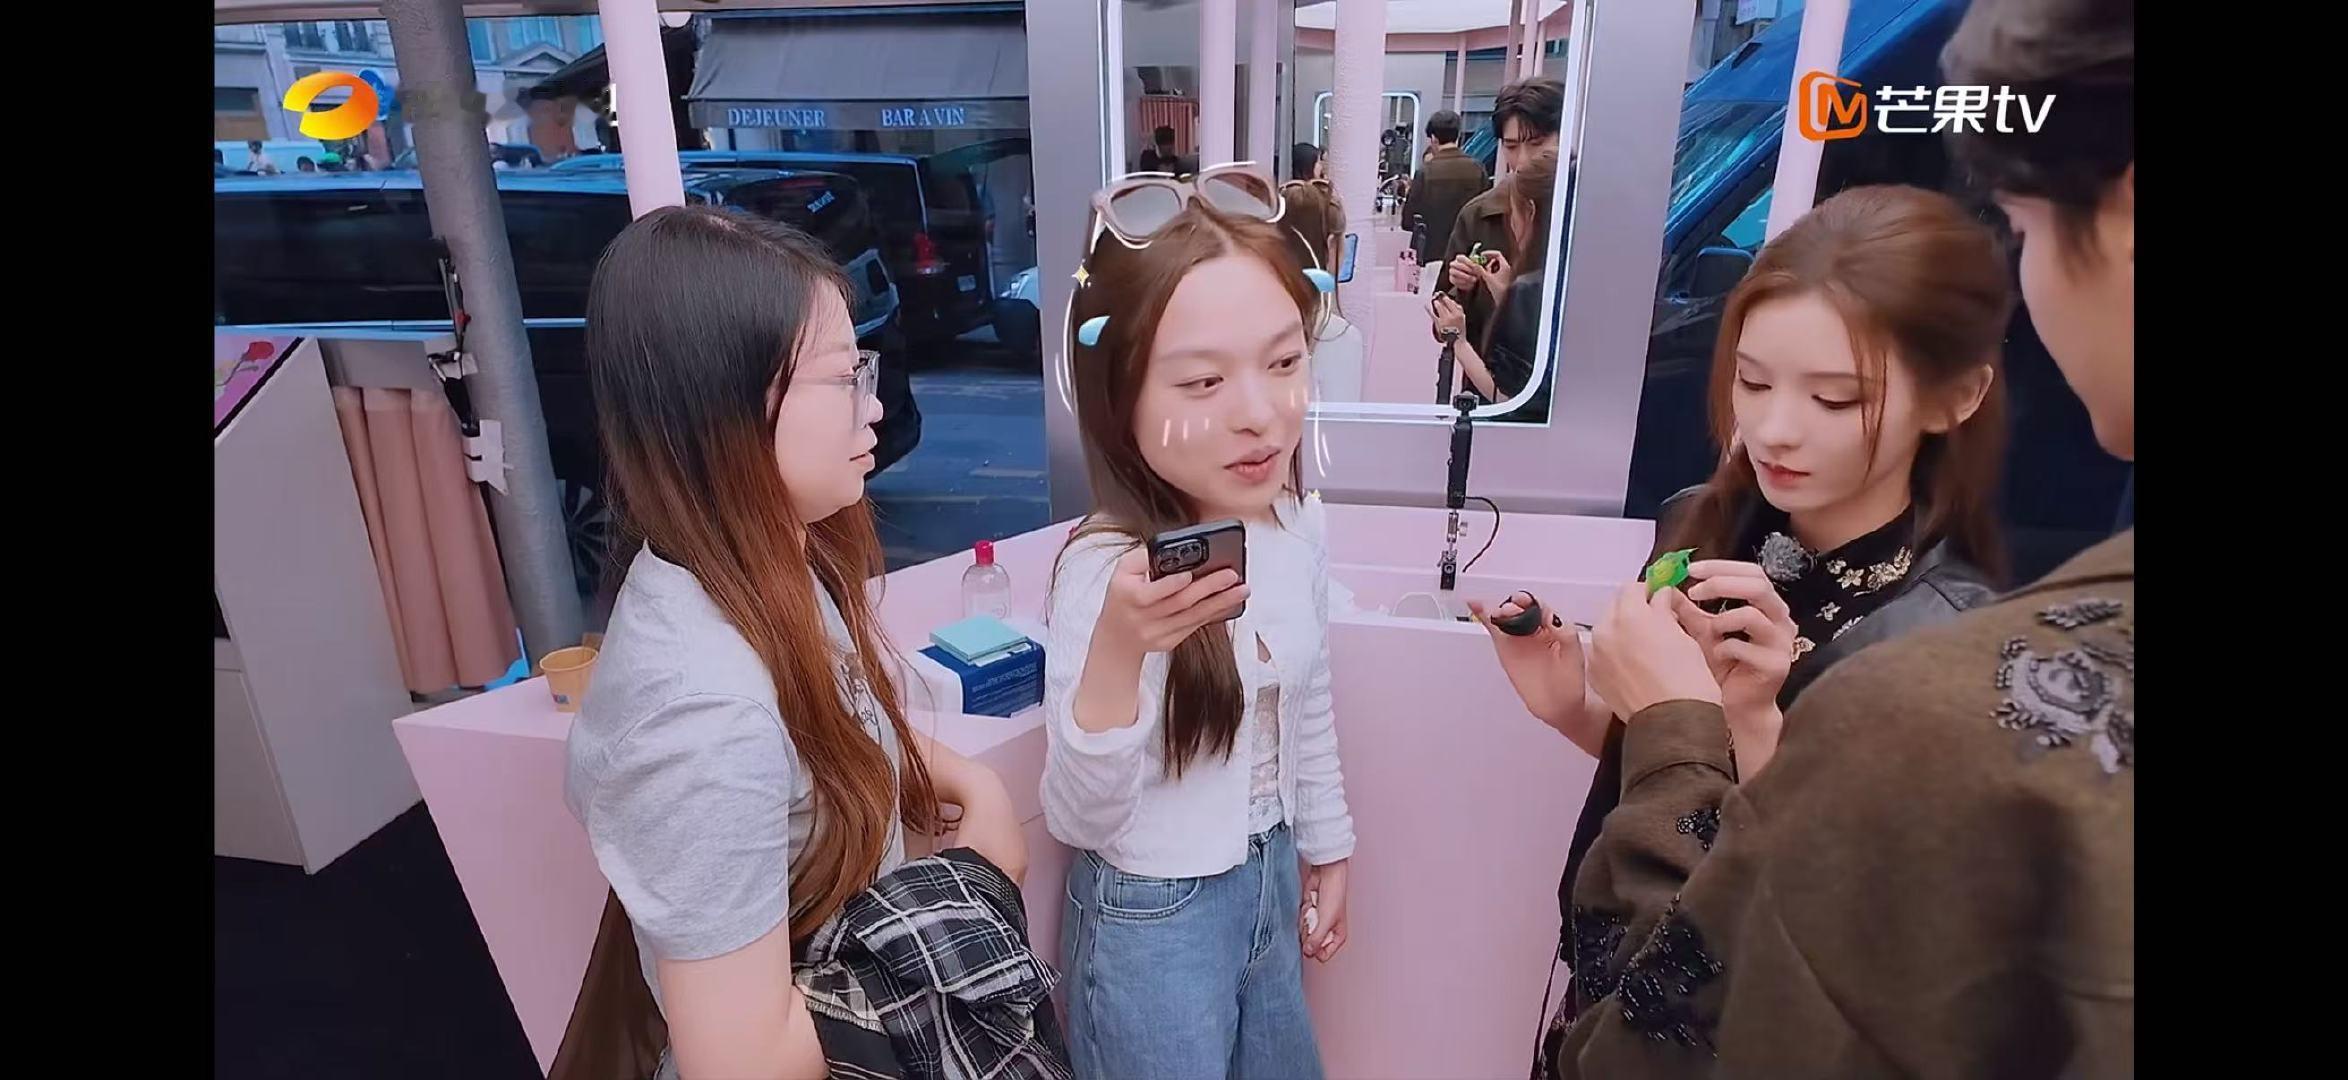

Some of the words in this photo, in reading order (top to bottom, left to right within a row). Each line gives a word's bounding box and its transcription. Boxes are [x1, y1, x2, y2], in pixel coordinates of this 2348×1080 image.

[727, 108, 826, 127] DEJEUNER
[881, 108, 916, 127] BAR
[919, 108, 932, 127] A
[933, 107, 965, 126] VIN
